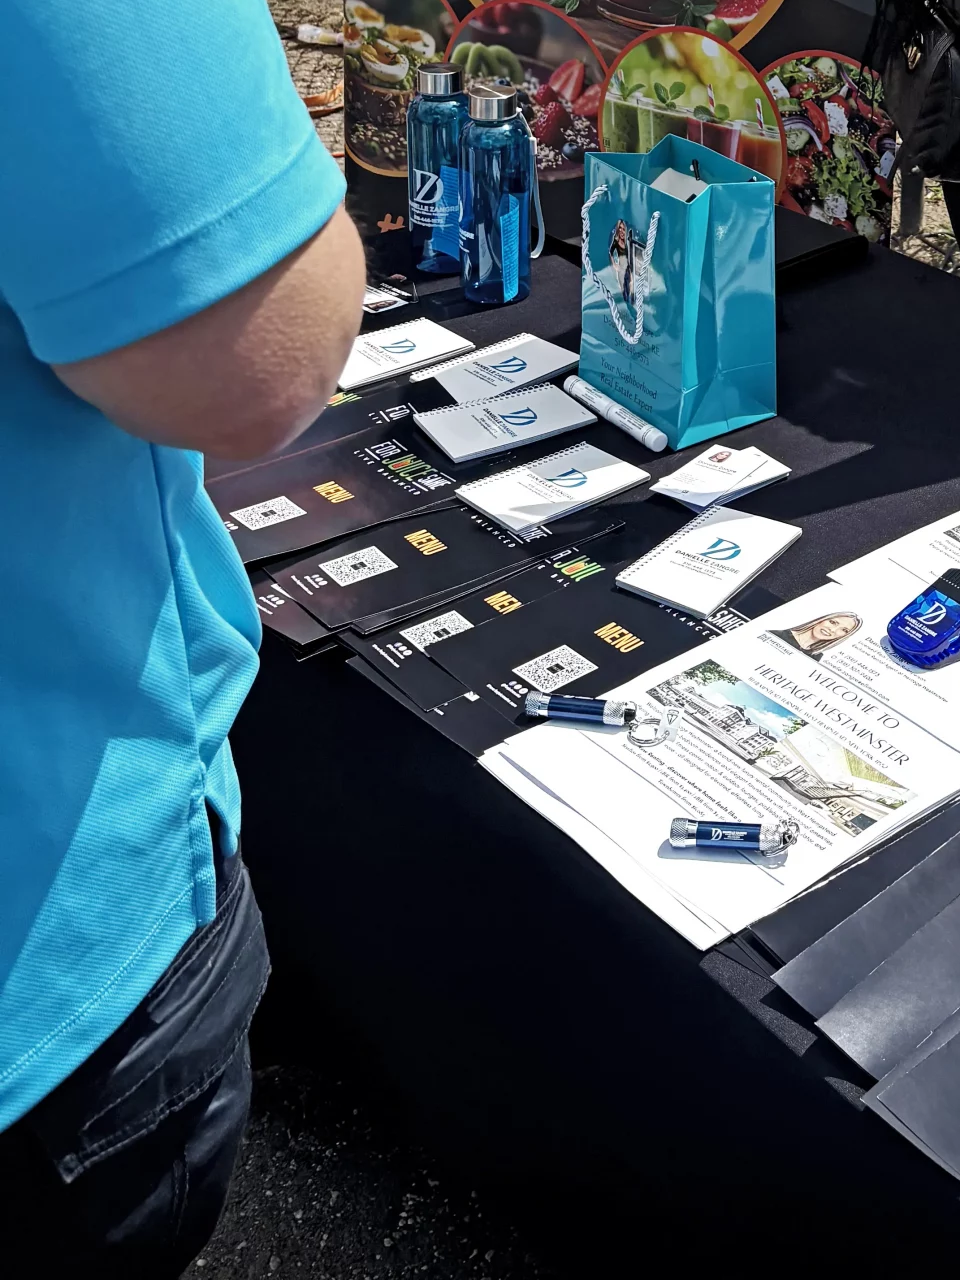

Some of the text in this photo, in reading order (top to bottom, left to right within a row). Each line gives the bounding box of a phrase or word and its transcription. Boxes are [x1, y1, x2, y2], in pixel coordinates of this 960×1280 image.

[615, 363, 657, 401] Neighborhood
[614, 380, 632, 400] Estate
[634, 392, 653, 414] Expert
[371, 441, 401, 458] FOR
[382, 454, 438, 481] JUICE
[312, 481, 355, 503] MENU
[404, 530, 448, 556] MENU
[675, 549, 740, 575] DANIELLE ZANGRE
[484, 590, 522, 615] MEN
[594, 622, 645, 653] MENU
[805, 668, 880, 715] WELCOME
[872, 711, 902, 730] TO
[752, 662, 817, 703] HERITAGE
[809, 699, 913, 766] WESTMINSTER
